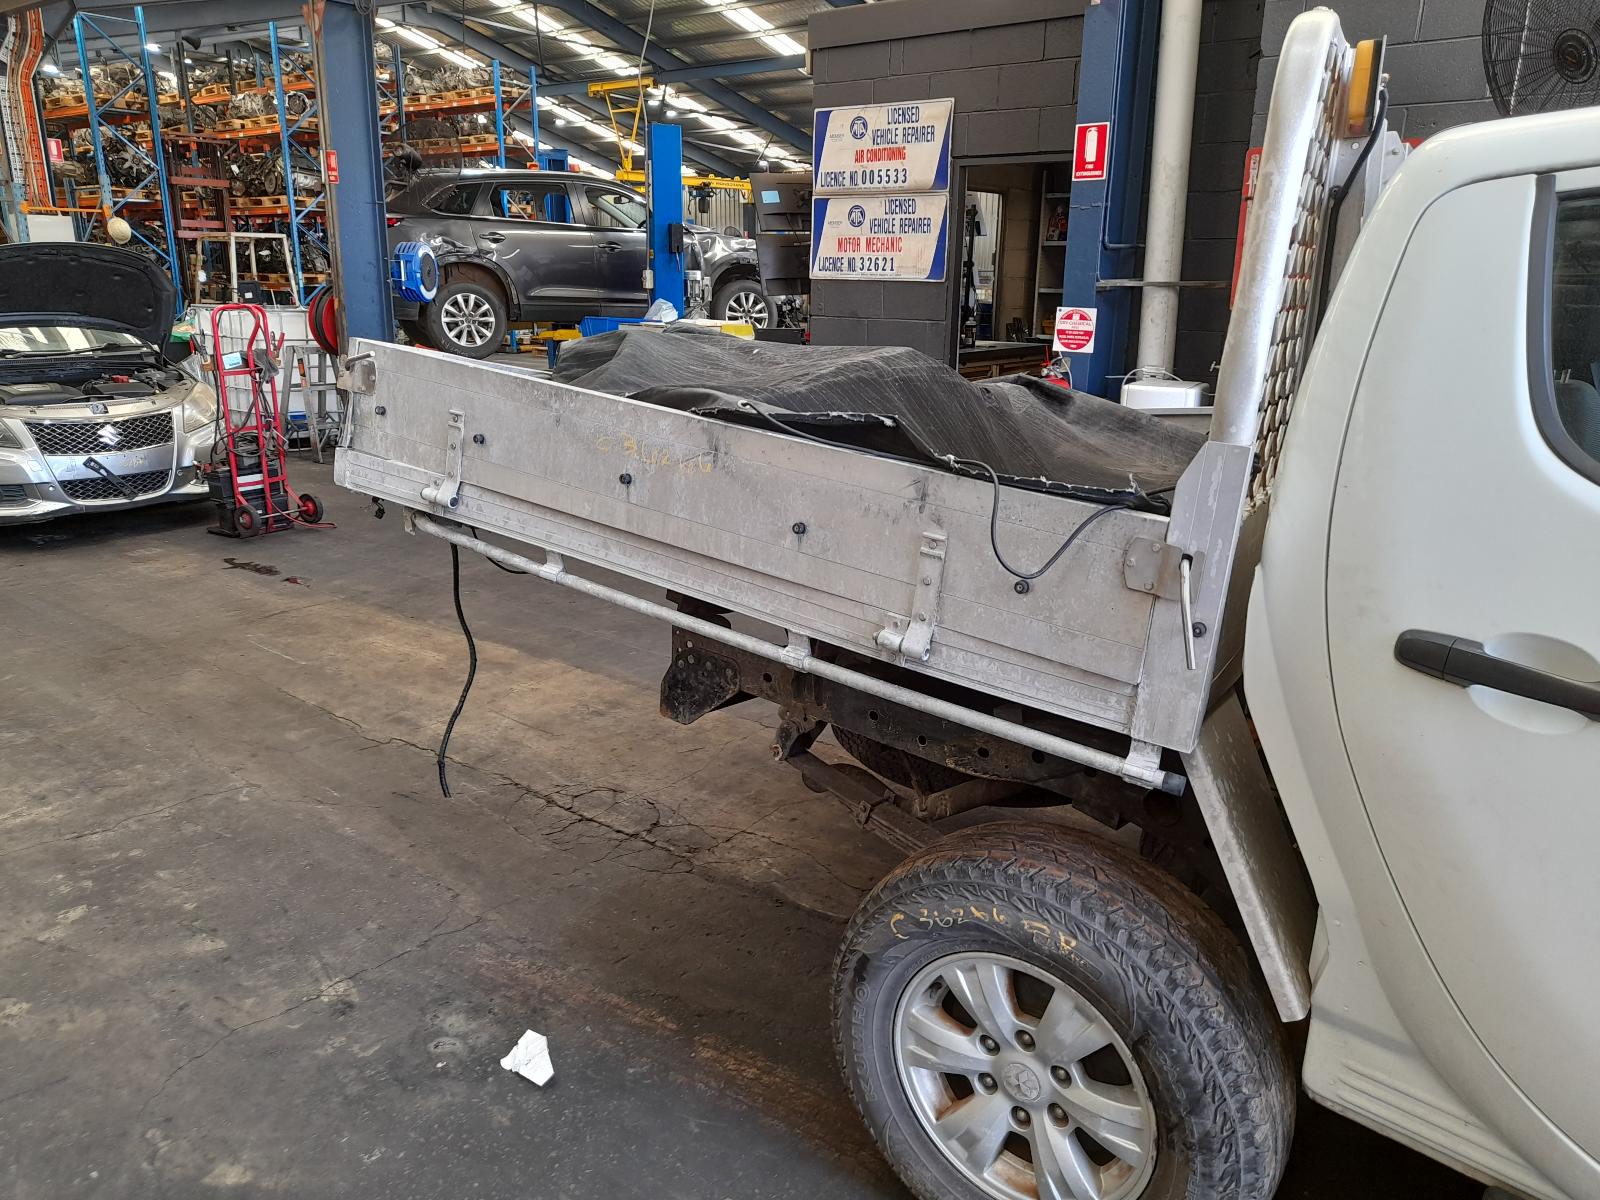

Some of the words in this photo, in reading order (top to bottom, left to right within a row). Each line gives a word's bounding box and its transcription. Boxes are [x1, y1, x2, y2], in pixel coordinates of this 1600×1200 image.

[887, 106, 920, 124] LICENSED
[872, 128, 898, 146] VEHICLE
[902, 125, 935, 144] REPAIRER
[854, 148, 864, 164] AIR
[866, 146, 906, 162] CONDITIONING
[820, 171, 846, 188] LICENCE
[884, 199, 916, 215] LICENSED
[869, 218, 896, 234] VEHICLE
[899, 217, 931, 234] REPAIRER
[837, 237, 861, 253] MOTOR
[865, 237, 903, 253] MECHANIC
[818, 256, 844, 272] LICENCE
[859, 257, 895, 272] 32621
